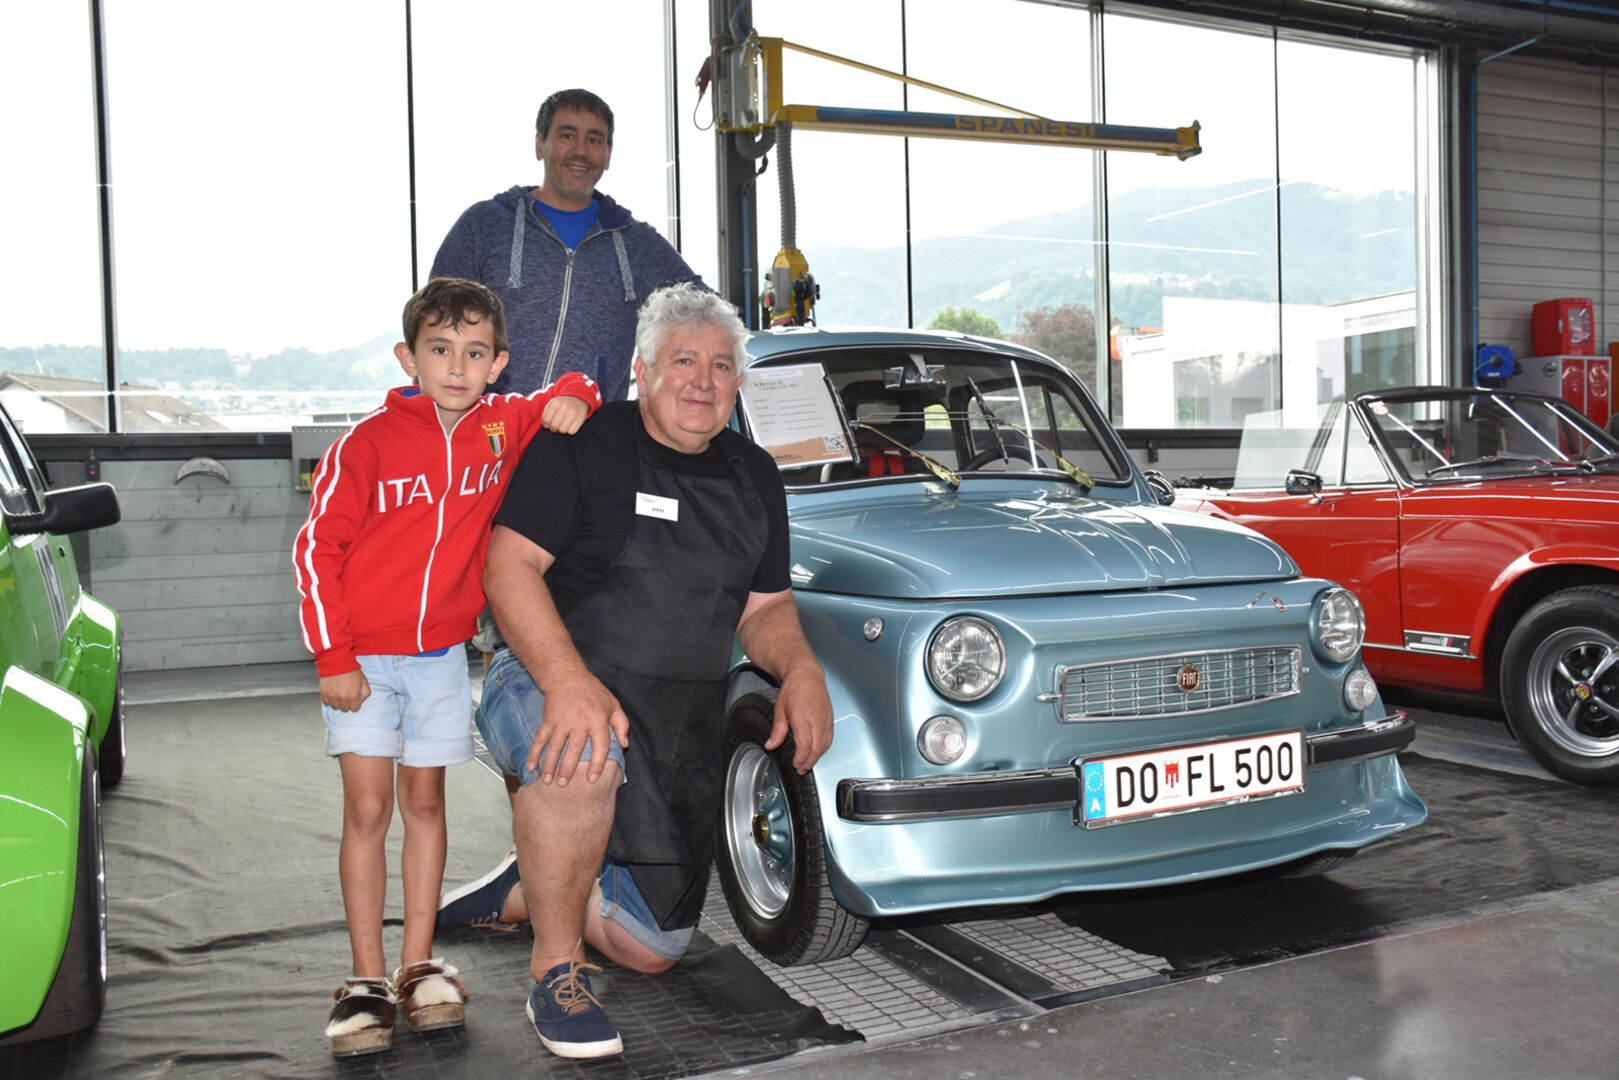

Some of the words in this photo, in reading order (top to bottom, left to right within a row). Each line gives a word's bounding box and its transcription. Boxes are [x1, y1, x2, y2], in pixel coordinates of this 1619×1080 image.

[958, 116, 1092, 138] SPANESI
[1116, 762, 1158, 808] DO
[1090, 798, 1101, 812] A
